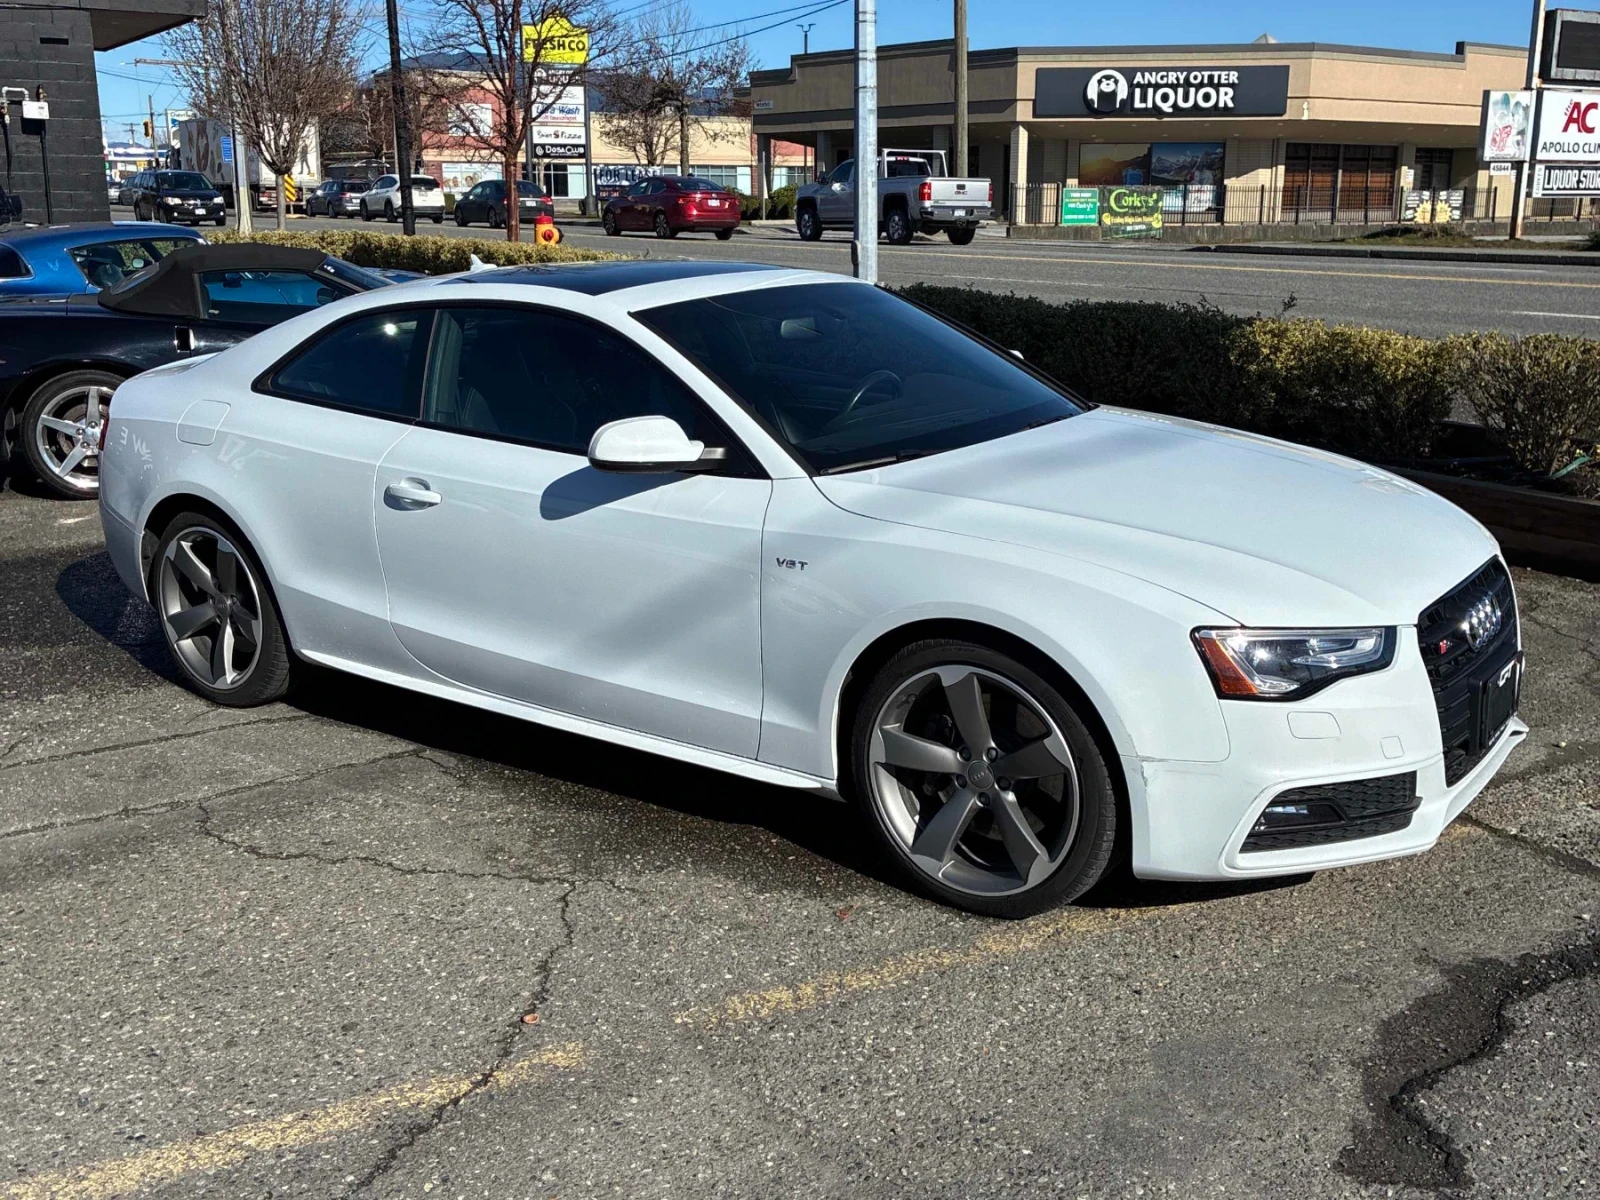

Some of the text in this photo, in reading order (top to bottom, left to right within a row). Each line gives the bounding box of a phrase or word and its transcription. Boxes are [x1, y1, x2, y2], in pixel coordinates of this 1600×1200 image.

[525, 37, 586, 52] FSHCO
[1133, 70, 1239, 85] ANGRY OTTER
[1133, 86, 1235, 113] LIQUOR
[558, 105, 581, 115] Wash
[1561, 101, 1599, 134] AC
[1540, 141, 1580, 154] APOLLO
[599, 168, 621, 181] FOR
[1543, 168, 1579, 191] LIQUOR
